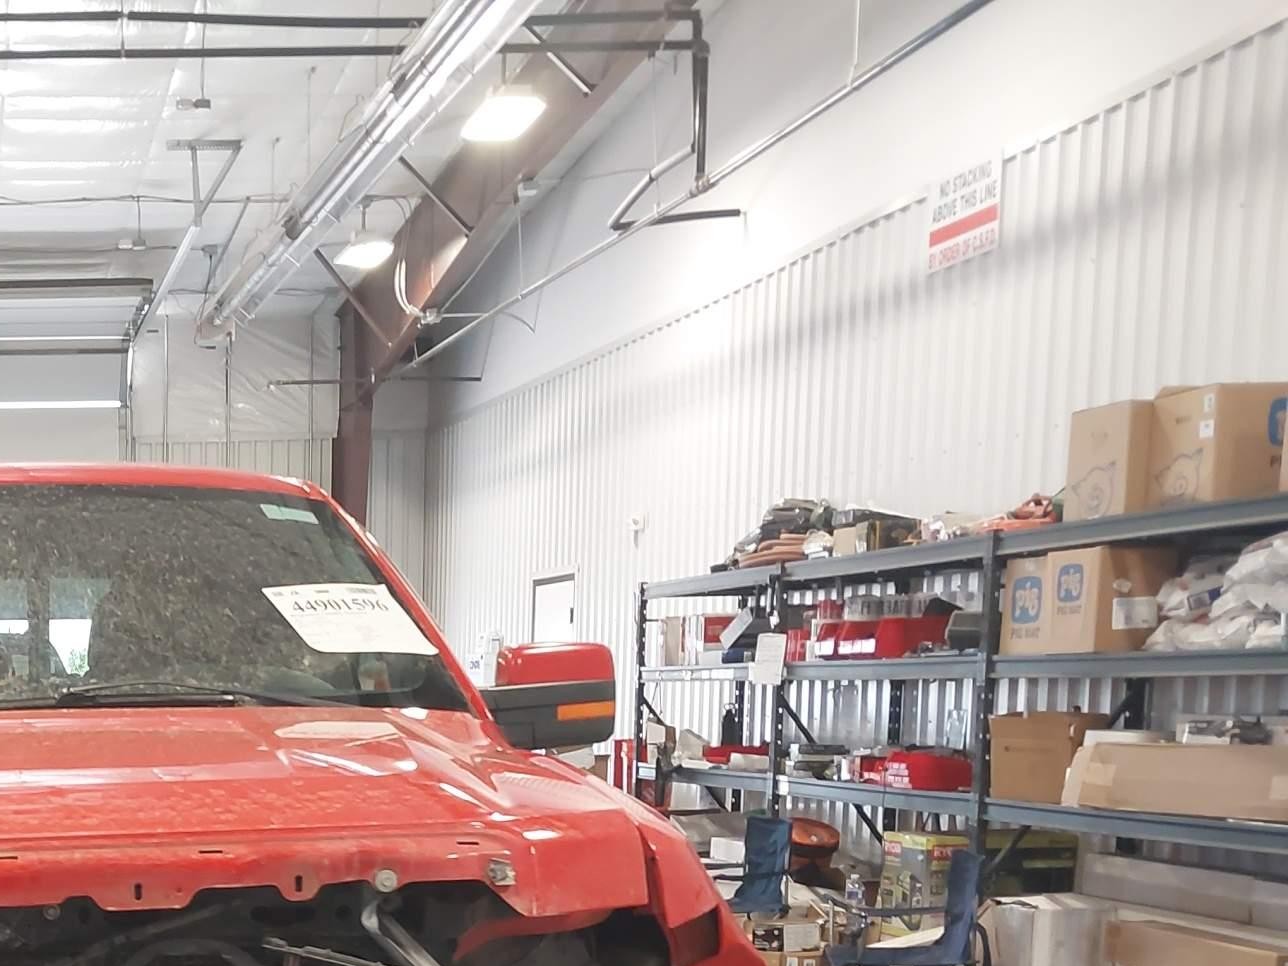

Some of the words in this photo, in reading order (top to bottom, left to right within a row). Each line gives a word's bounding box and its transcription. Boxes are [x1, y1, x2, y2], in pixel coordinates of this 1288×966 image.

[952, 160, 993, 194] STACKING
[932, 198, 958, 224] ABOVE
[960, 188, 978, 212] THIS
[979, 179, 998, 205] LINE
[292, 599, 389, 612] 44901596
